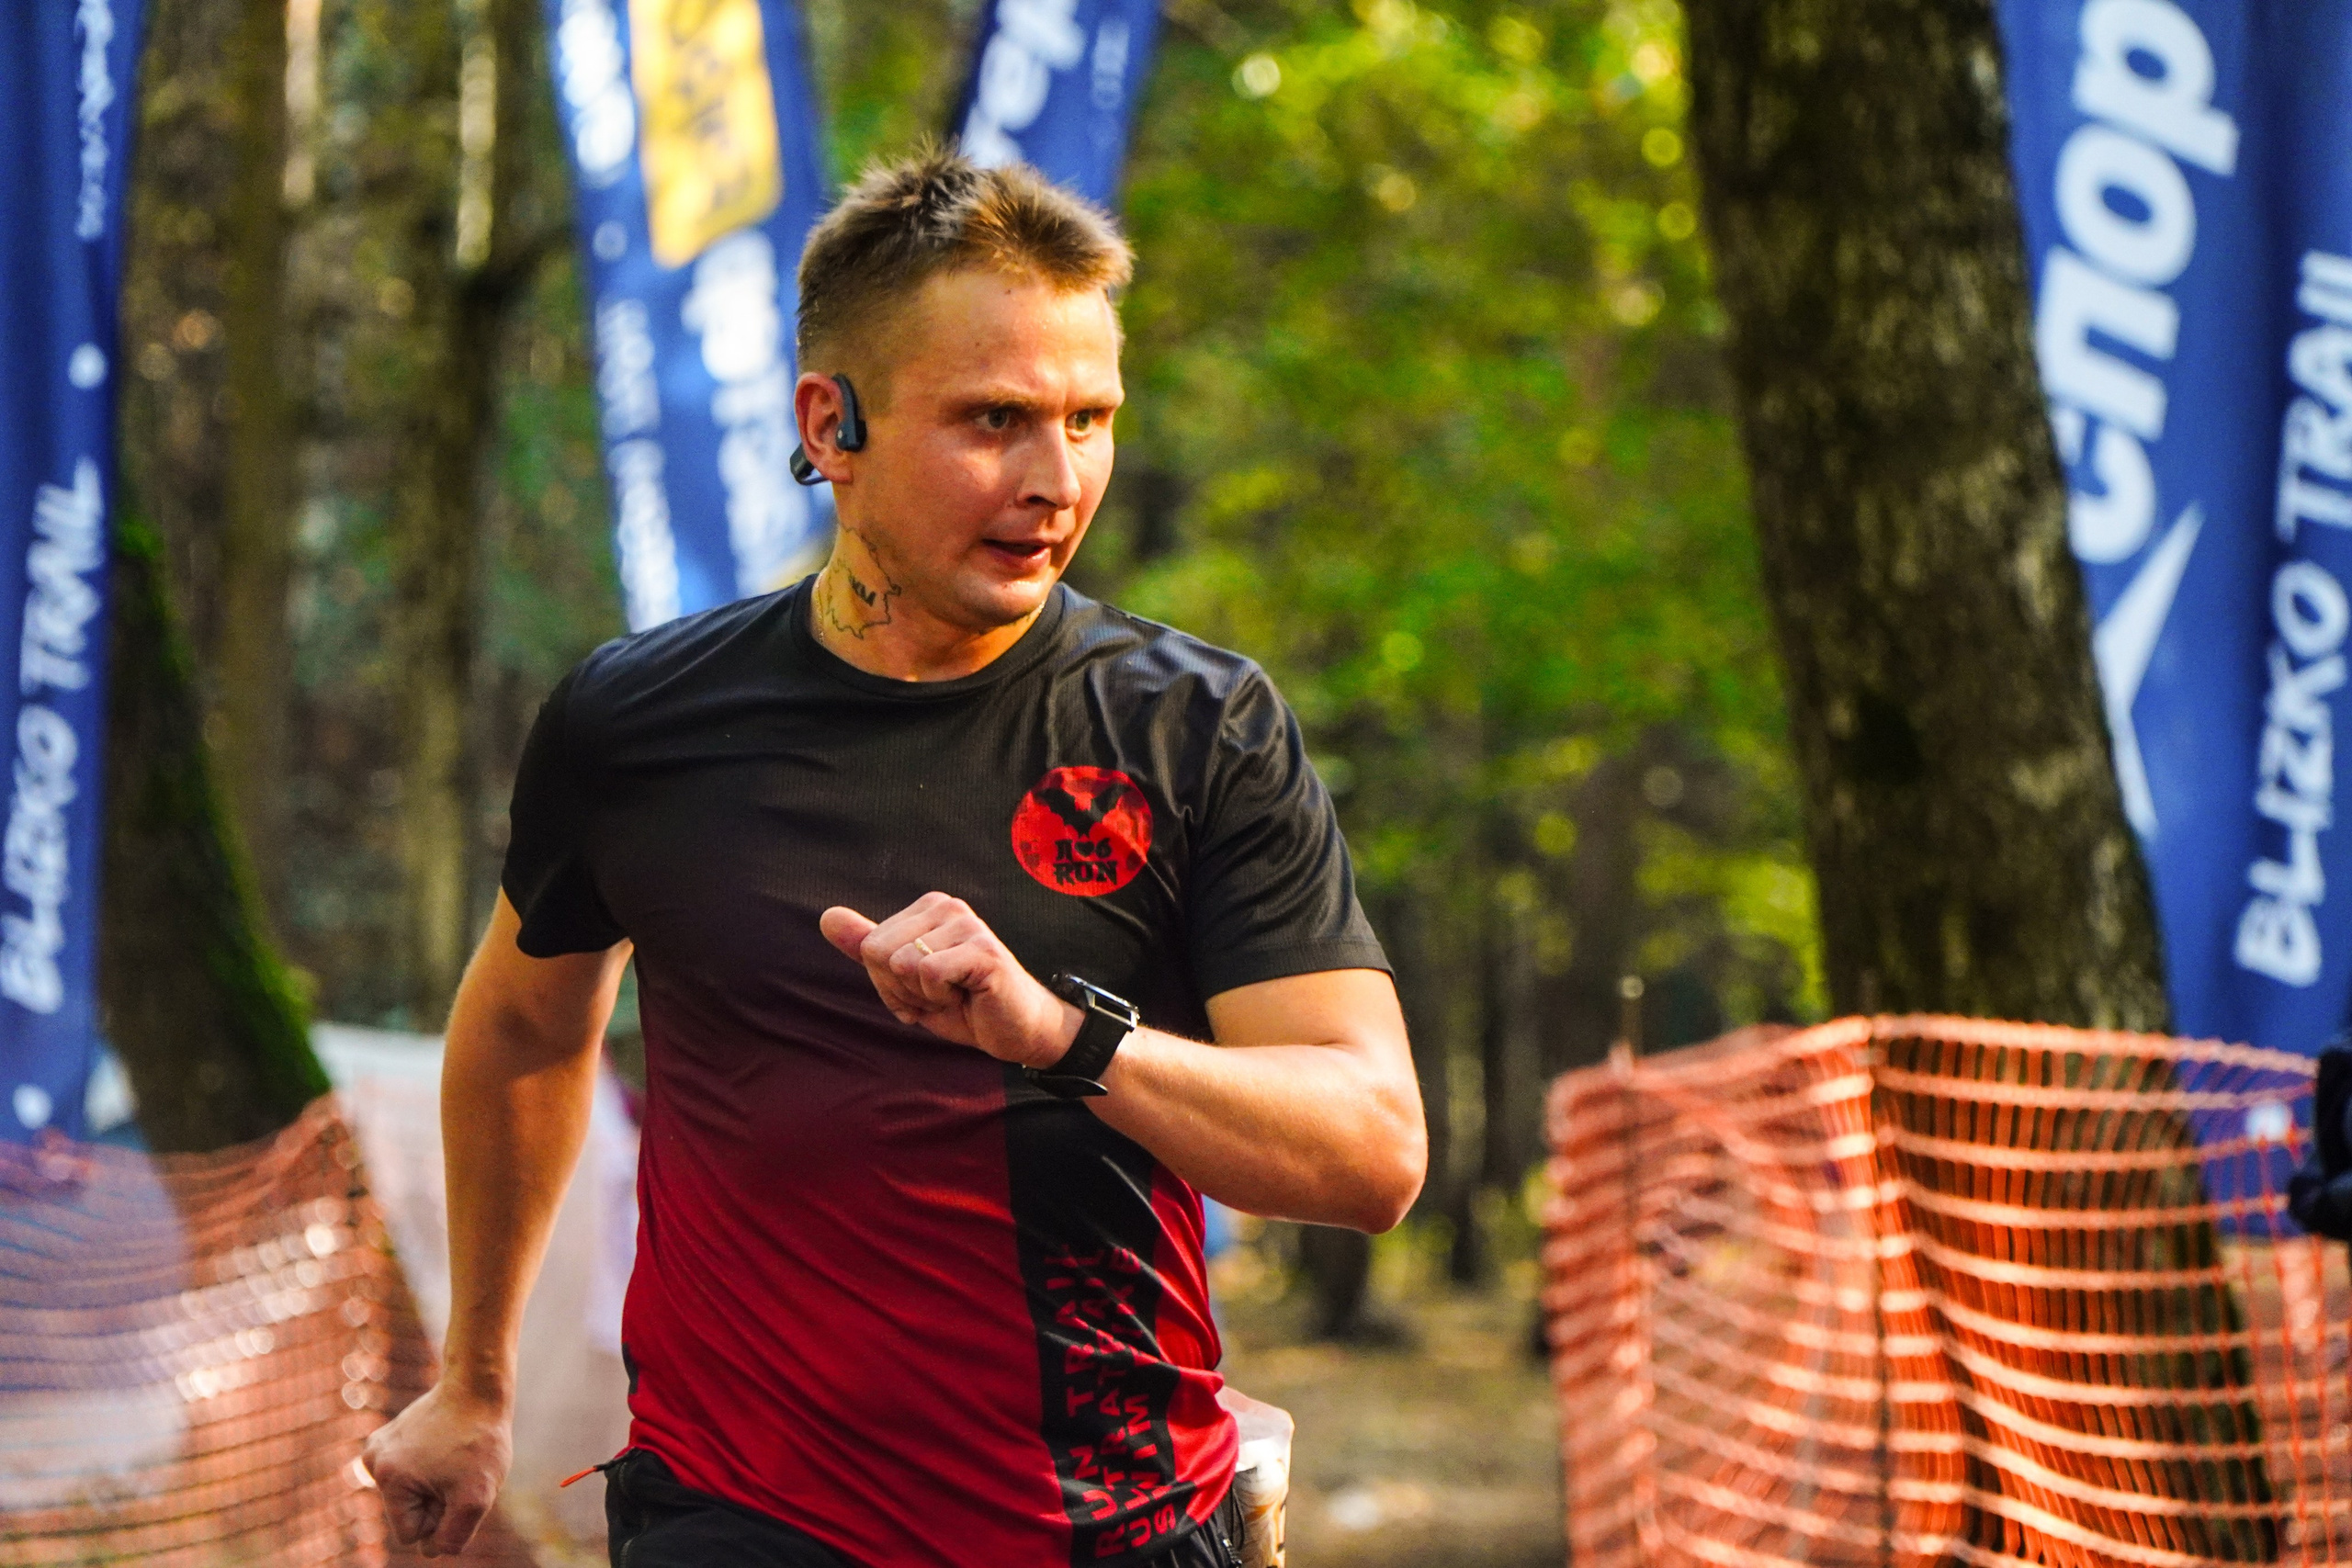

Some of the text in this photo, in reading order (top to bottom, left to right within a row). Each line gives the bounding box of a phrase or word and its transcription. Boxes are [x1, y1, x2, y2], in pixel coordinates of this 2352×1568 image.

[19, 457, 104, 694] TRAIL
[1053, 861, 1117, 886] RUN
[2233, 560, 2349, 987] BLIZKO
[1044, 1245, 1125, 1559] RUN TRAIL
[1124, 1393, 1176, 1535] SWIM
